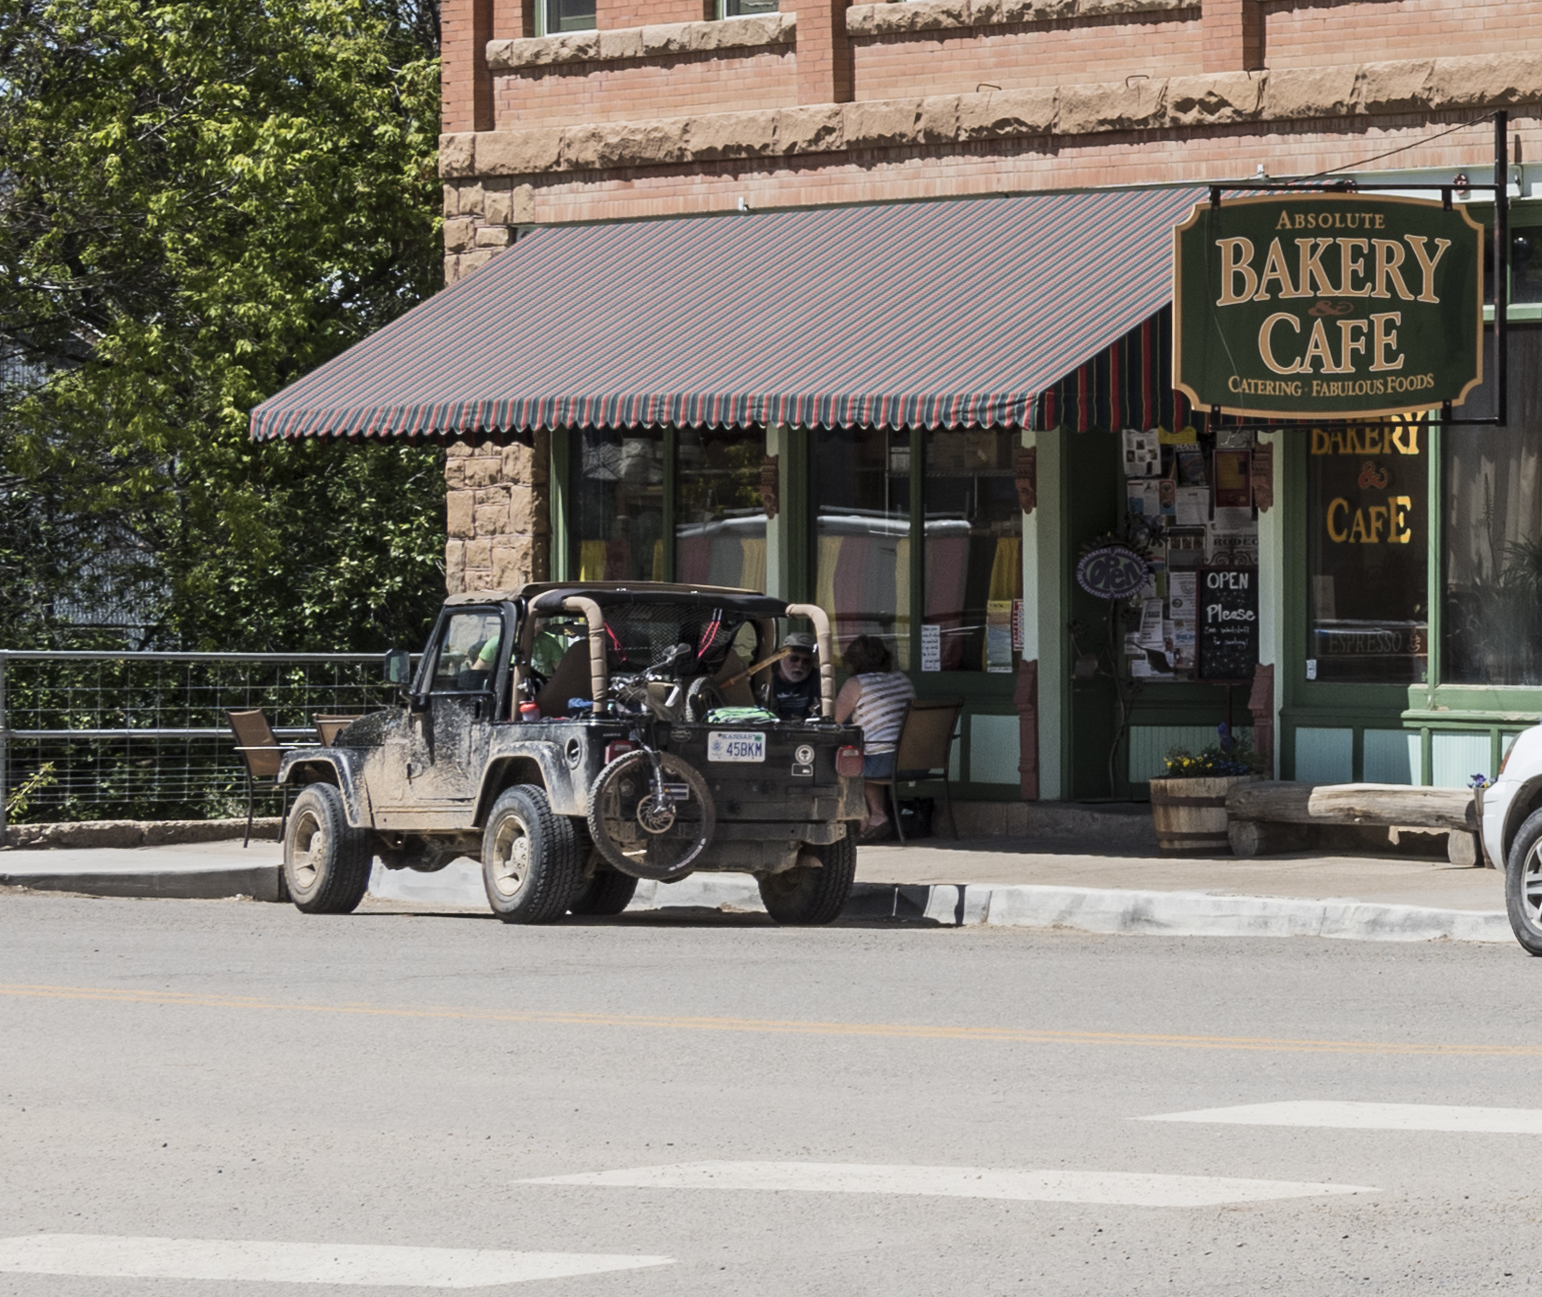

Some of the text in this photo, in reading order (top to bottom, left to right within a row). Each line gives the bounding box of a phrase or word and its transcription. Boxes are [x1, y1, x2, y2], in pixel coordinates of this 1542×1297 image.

[1275, 210, 1386, 230] ABSOLUTE
[1215, 234, 1452, 307] BAKERY
[1307, 300, 1354, 317] &
[1258, 311, 1405, 375] CAFE
[1228, 373, 1434, 397] CATERING FABULOUS FOODS
[1311, 411, 1427, 455] BAKERY
[1358, 460, 1388, 490] &
[1327, 496, 1412, 543] CAFE
[1207, 572, 1249, 589] OPEN
[1206, 603, 1256, 623] Please
[1329, 631, 1402, 653] ESPRESSO
[726, 741, 763, 757] 45BKM
